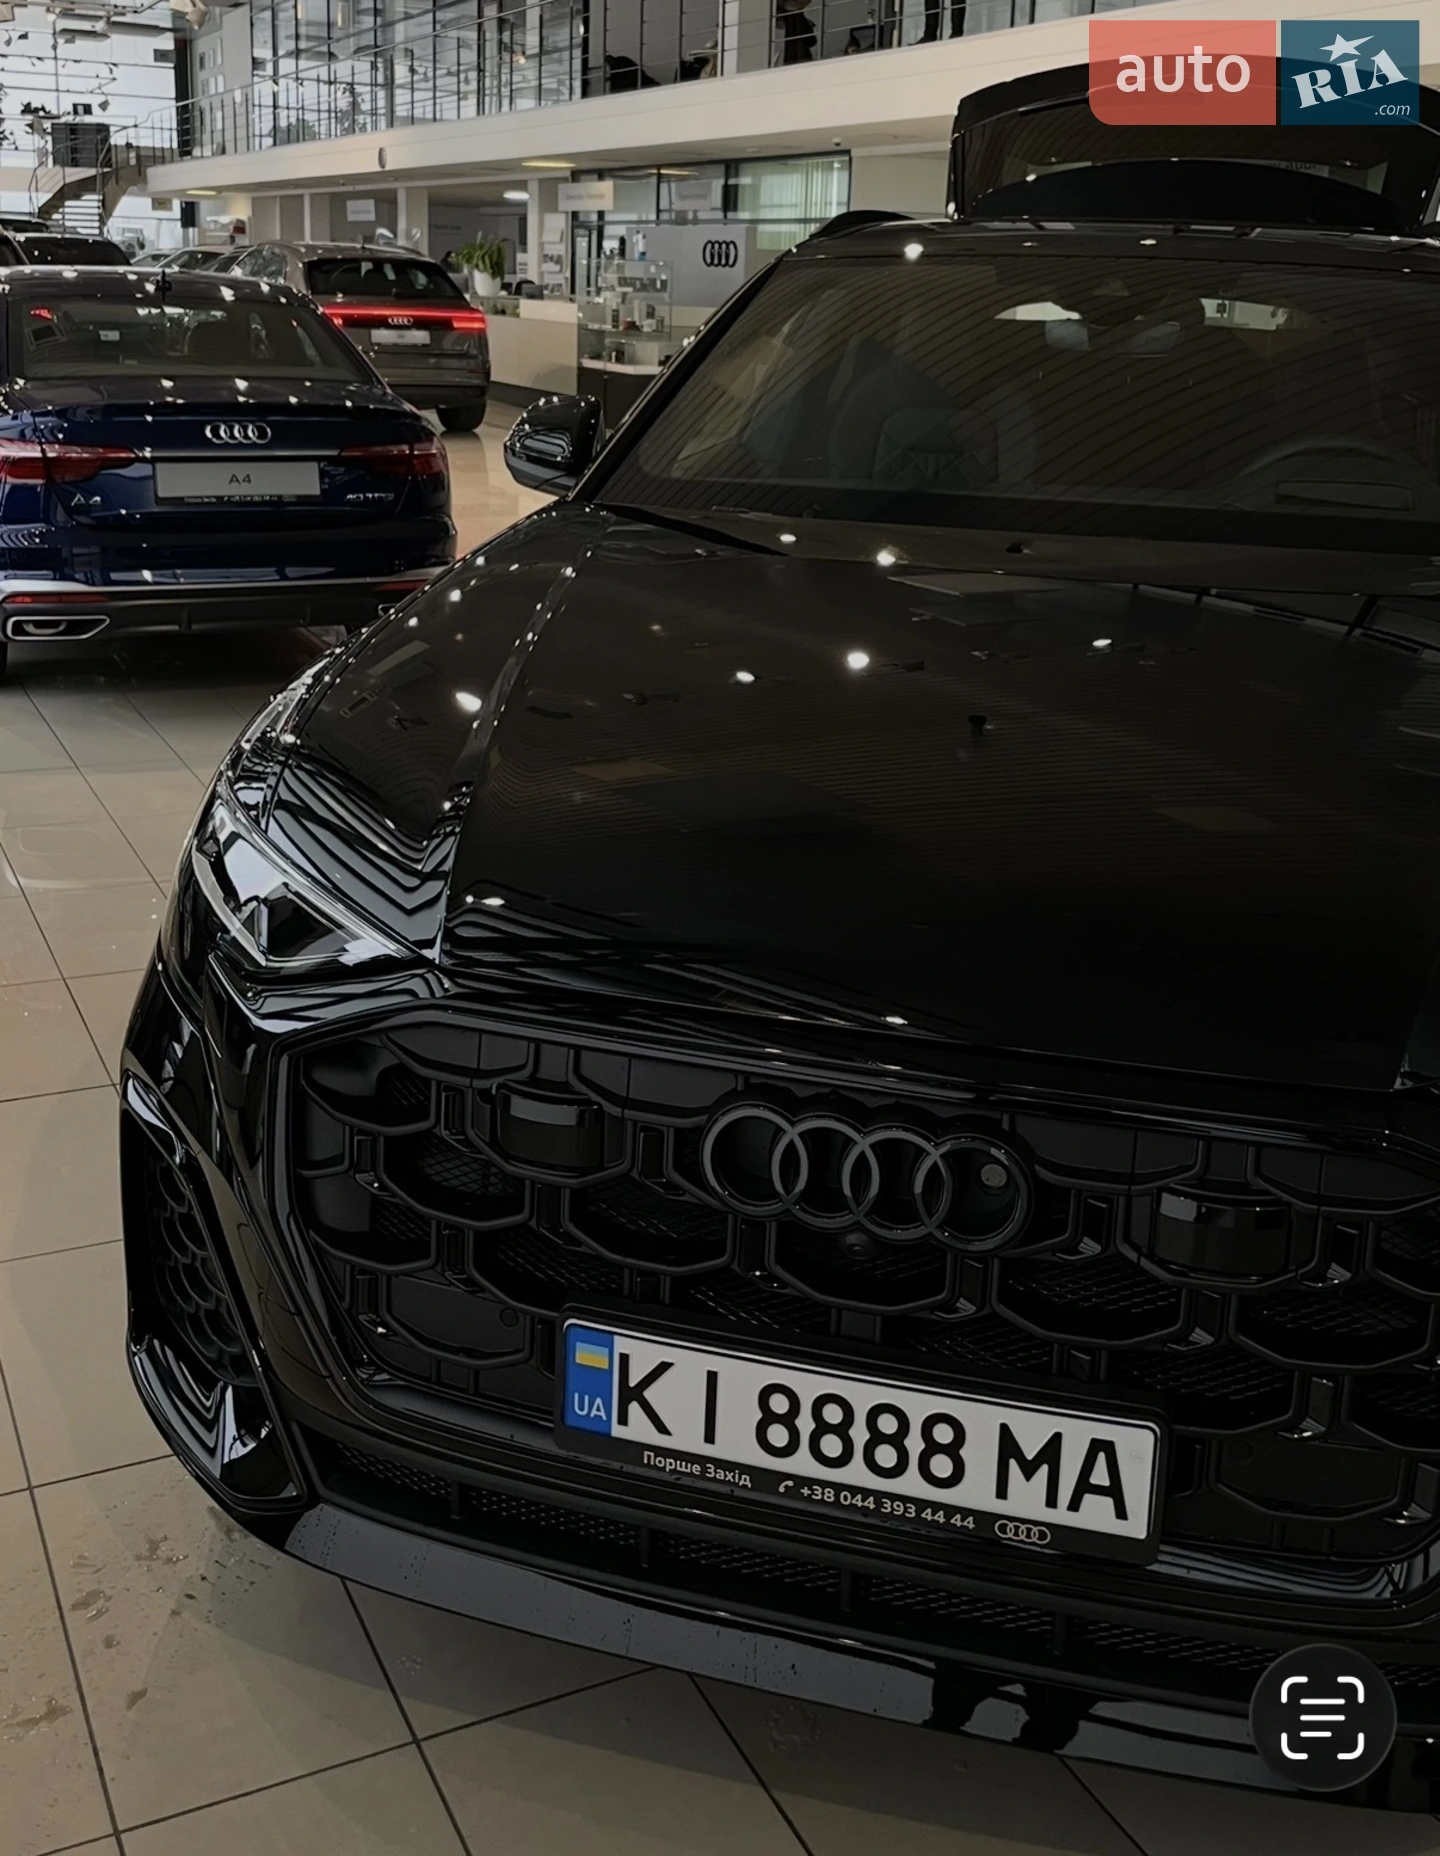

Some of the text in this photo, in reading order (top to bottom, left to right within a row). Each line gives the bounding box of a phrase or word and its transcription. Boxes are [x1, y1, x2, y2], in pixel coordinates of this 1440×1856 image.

[228, 471, 252, 485] A4
[573, 1392, 607, 1421] UA
[642, 1451, 752, 1488] Порше Захід
[755, 1382, 967, 1489] 8888
[995, 1422, 1129, 1521] MA
[799, 1484, 975, 1530] +38 044 393 44 44
